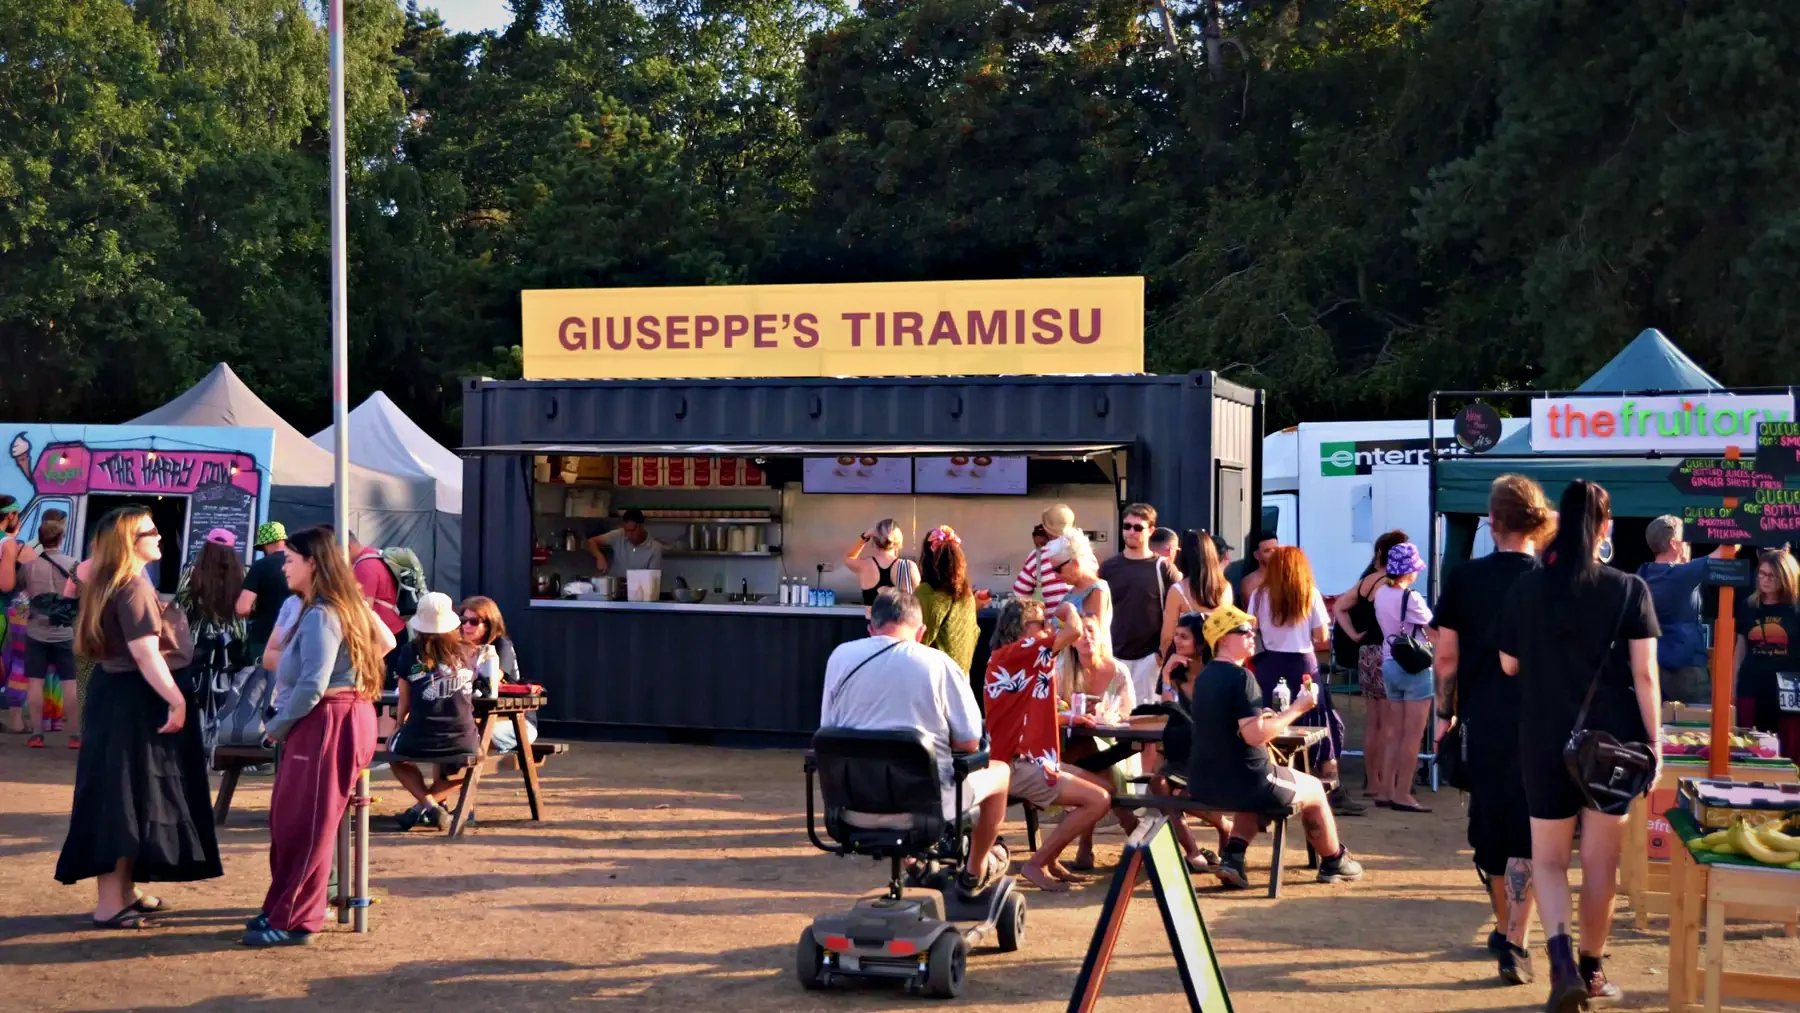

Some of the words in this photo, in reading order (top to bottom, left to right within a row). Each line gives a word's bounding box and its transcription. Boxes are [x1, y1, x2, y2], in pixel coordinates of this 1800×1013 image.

[558, 312, 819, 351] GIUSEPPE’S
[841, 307, 1102, 347] TIRAMISU
[1760, 423, 1799, 436] QUEUE
[98, 453, 135, 486] THE
[140, 453, 196, 489] HAPPY
[196, 459, 235, 487] COW
[1685, 459, 1715, 468] QUEUE
[1720, 460, 1735, 470] ON
[1738, 461, 1754, 470] THE
[1691, 477, 1724, 487] GINGER
[1755, 489, 1800, 504] QUEUE
[1684, 507, 1715, 518] QUEUE
[1763, 504, 1800, 517] BOTTL
